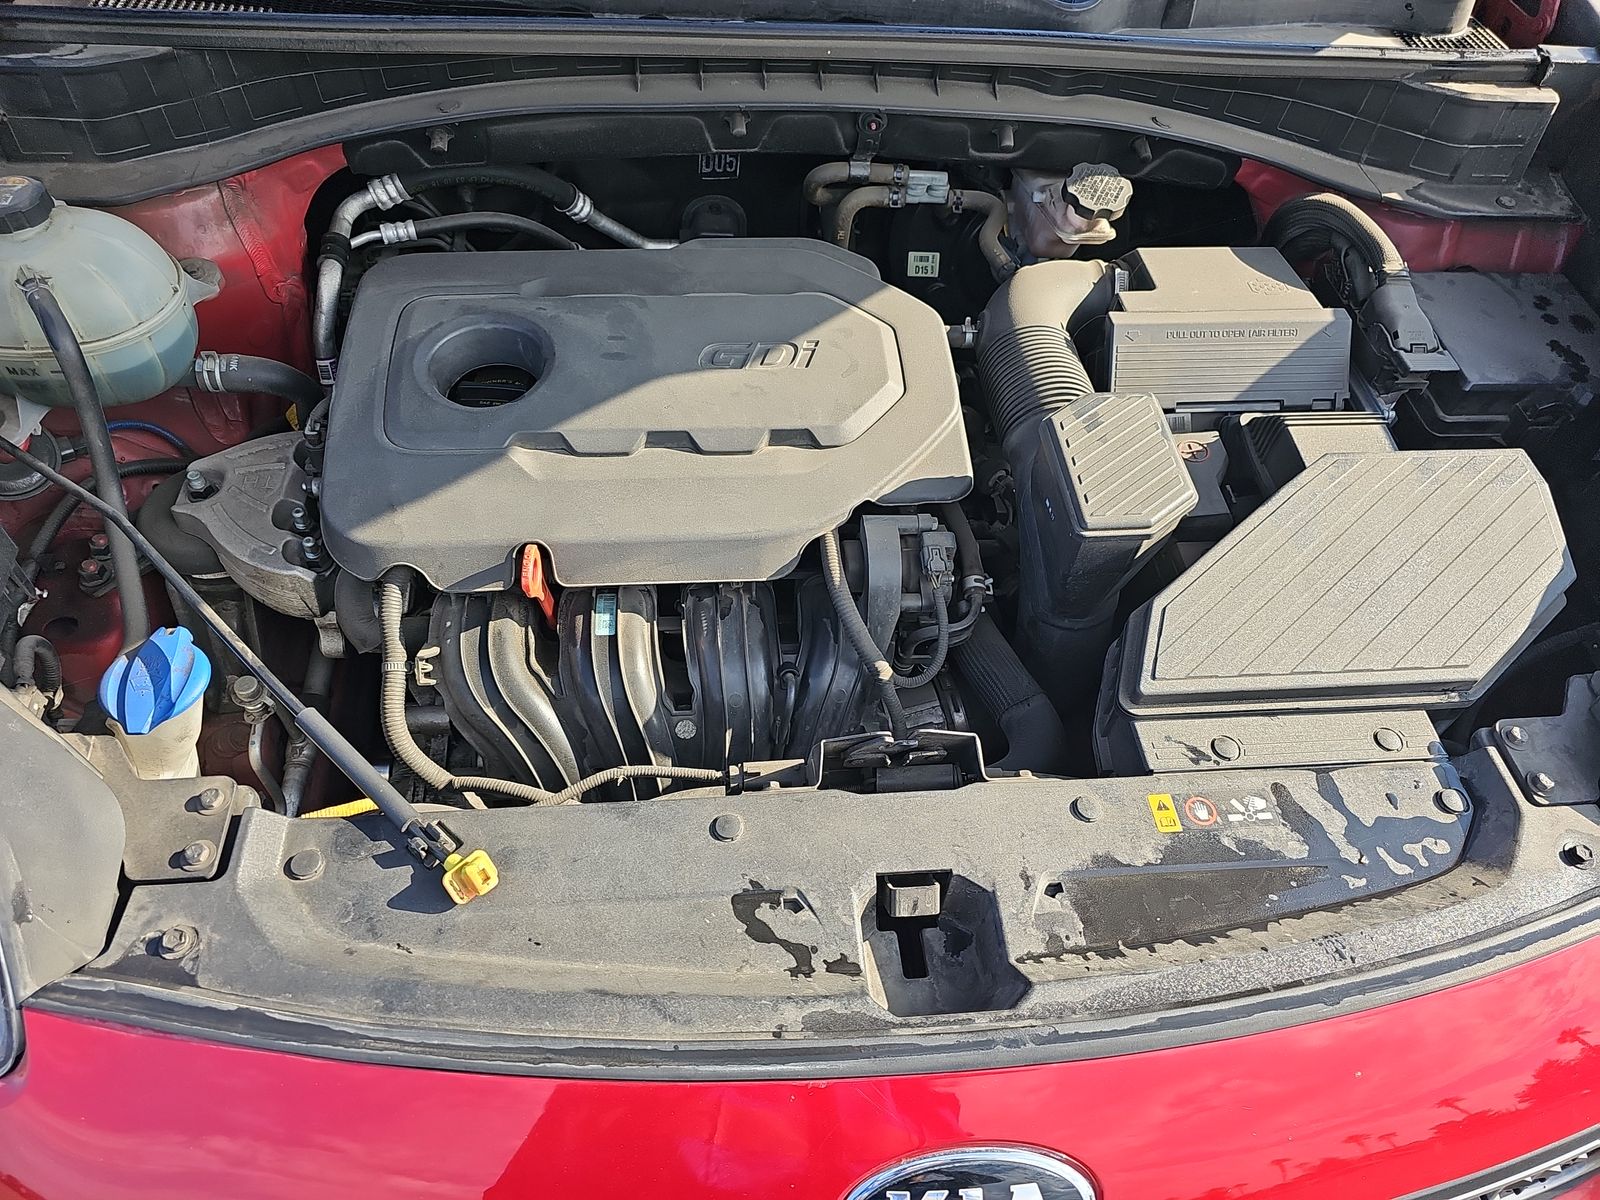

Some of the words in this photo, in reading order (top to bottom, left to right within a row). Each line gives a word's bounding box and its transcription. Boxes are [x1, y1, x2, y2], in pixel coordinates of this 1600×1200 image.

[914, 265, 929, 275] D15
[1166, 330, 1188, 339] PULL
[1189, 330, 1206, 339] OUT
[1208, 329, 1220, 338] TO
[1221, 329, 1245, 338] OPEN
[1267, 328, 1298, 337] FILTER)
[698, 339, 820, 369] GDi
[5, 366, 40, 376] MAX
